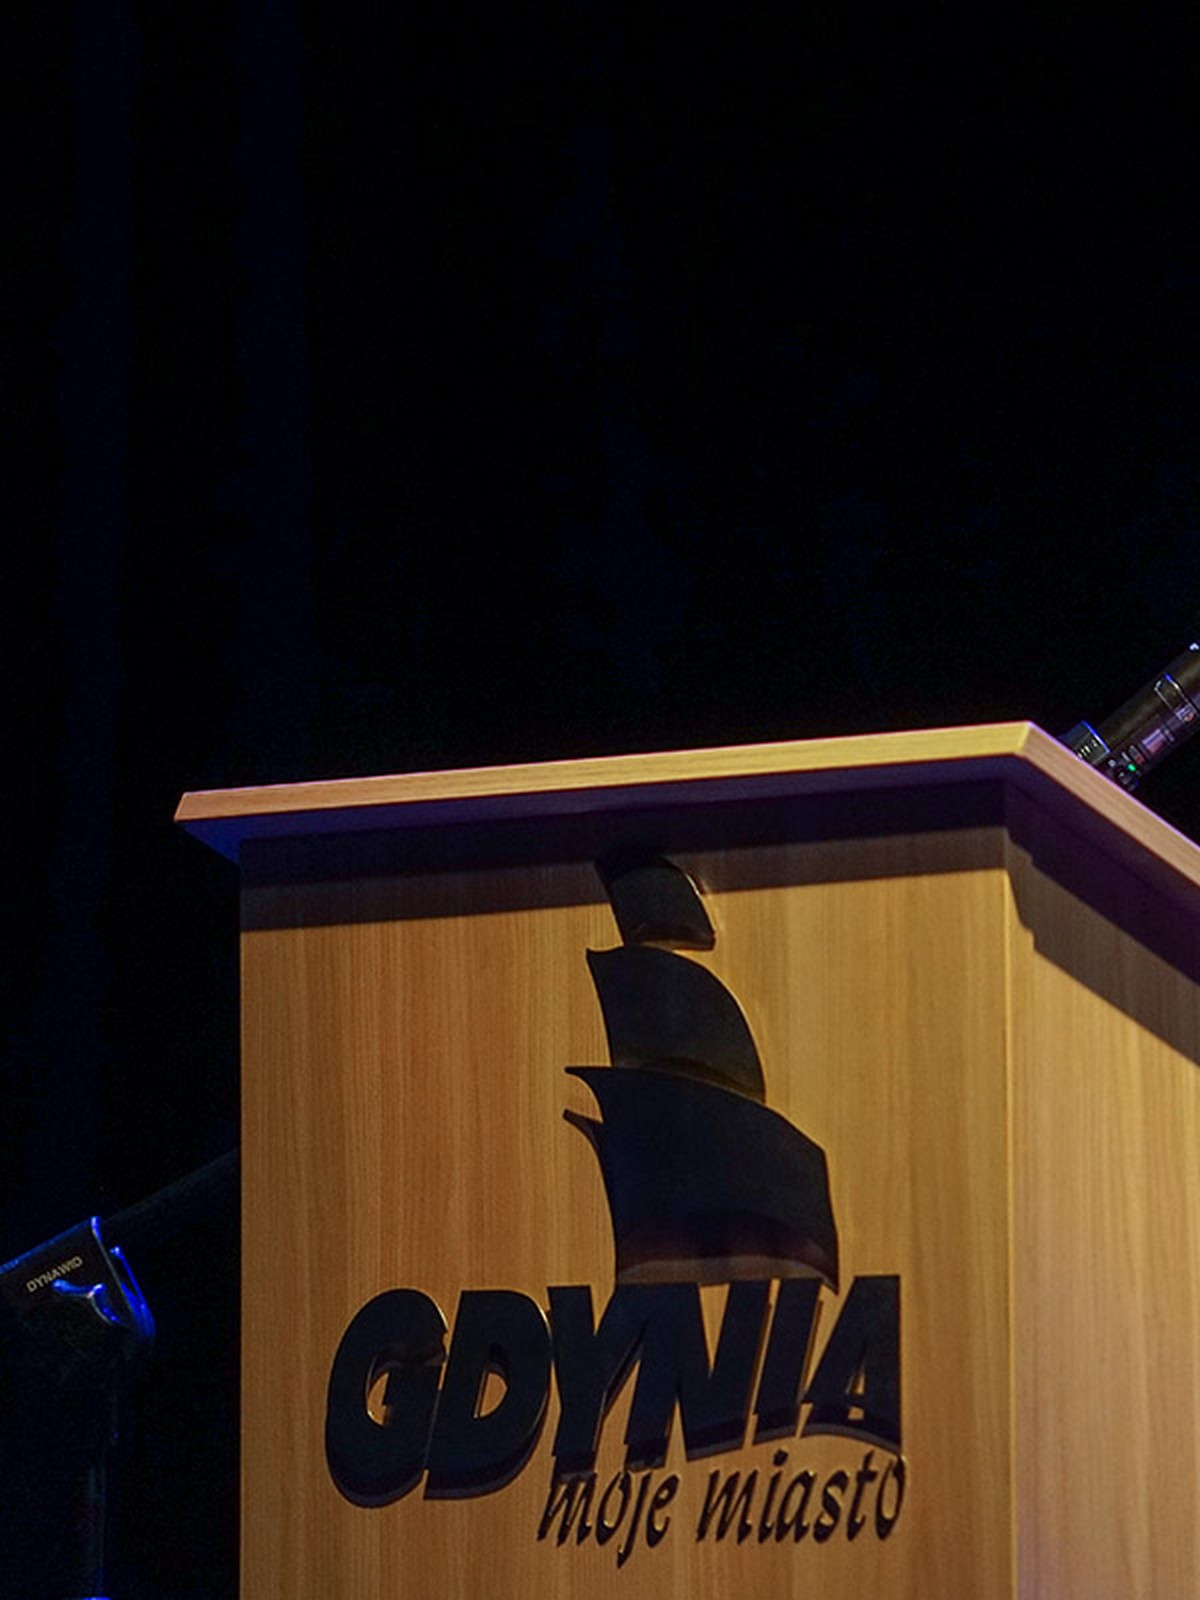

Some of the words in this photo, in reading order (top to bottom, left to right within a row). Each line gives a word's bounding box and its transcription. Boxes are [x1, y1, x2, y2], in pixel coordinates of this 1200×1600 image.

[325, 1275, 902, 1508] GDYNIA
[537, 1470, 680, 1568] moje
[696, 1449, 905, 1543] miasto
